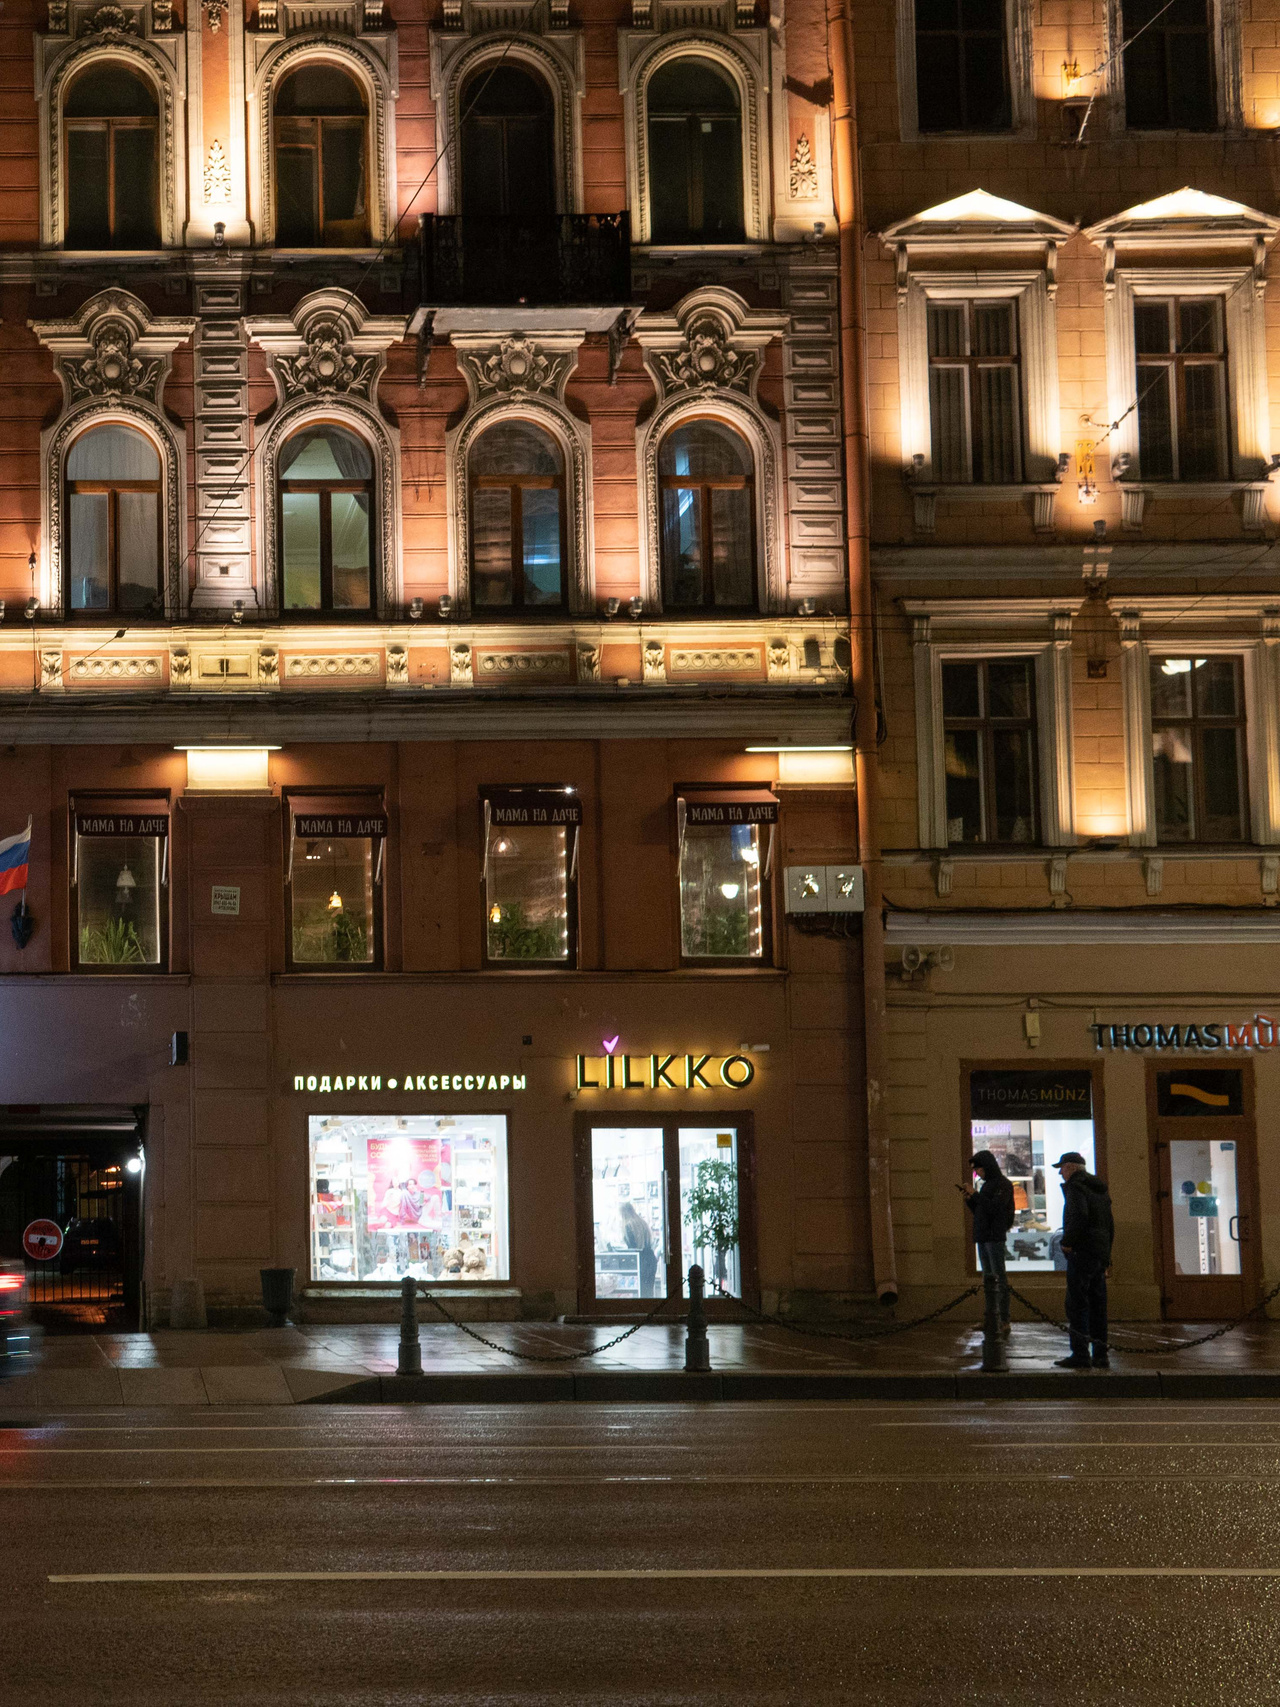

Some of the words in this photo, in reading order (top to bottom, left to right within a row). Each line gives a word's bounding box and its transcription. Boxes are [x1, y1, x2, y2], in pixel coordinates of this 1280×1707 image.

[496, 808, 528, 821] МАМА
[533, 808, 547, 821] НА
[552, 808, 579, 822] ДАЧЕ
[691, 807, 724, 821] МАМА
[728, 806, 743, 820] НА
[747, 806, 774, 821] ДАЧЕ
[82, 819, 115, 832] МАМА
[120, 819, 134, 832] НА
[138, 819, 166, 833] ДАЧЕ
[300, 820, 333, 833] МАМА
[338, 820, 352, 833] НА
[357, 820, 384, 834] ДАЧЕ
[576, 1053, 755, 1090] LILKKO
[294, 1075, 382, 1092] ПОДАРКИ
[403, 1074, 527, 1090] АКСЕССУАРЫ
